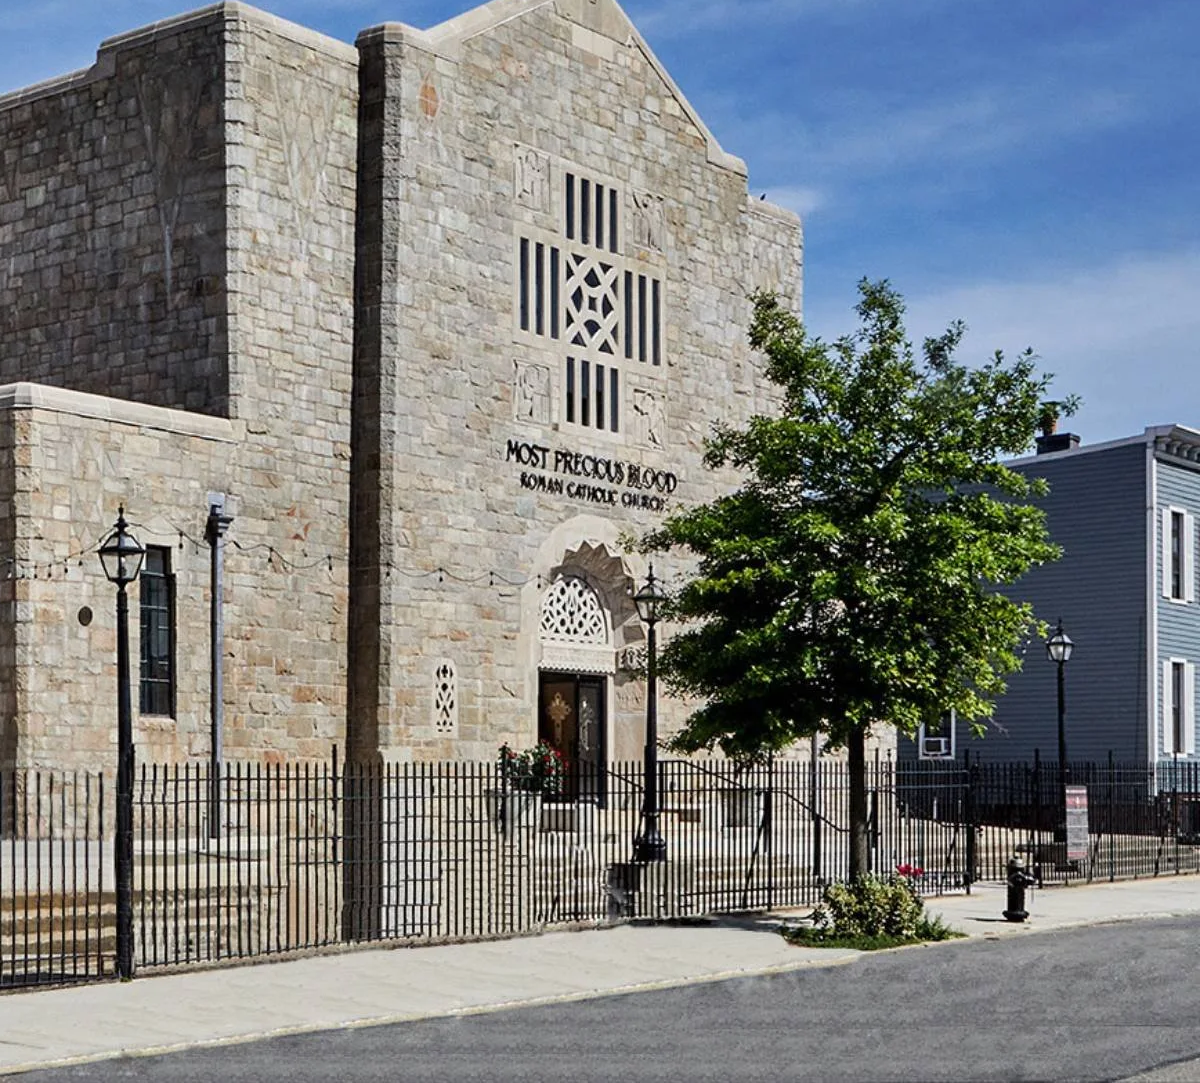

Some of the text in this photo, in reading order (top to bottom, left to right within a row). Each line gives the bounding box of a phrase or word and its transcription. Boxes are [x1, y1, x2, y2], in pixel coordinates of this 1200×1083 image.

[506, 439, 677, 493] MOST PRECIOUS BLOOD
[520, 472, 563, 495] ROMAN
[566, 481, 618, 506] CATHOLIC
